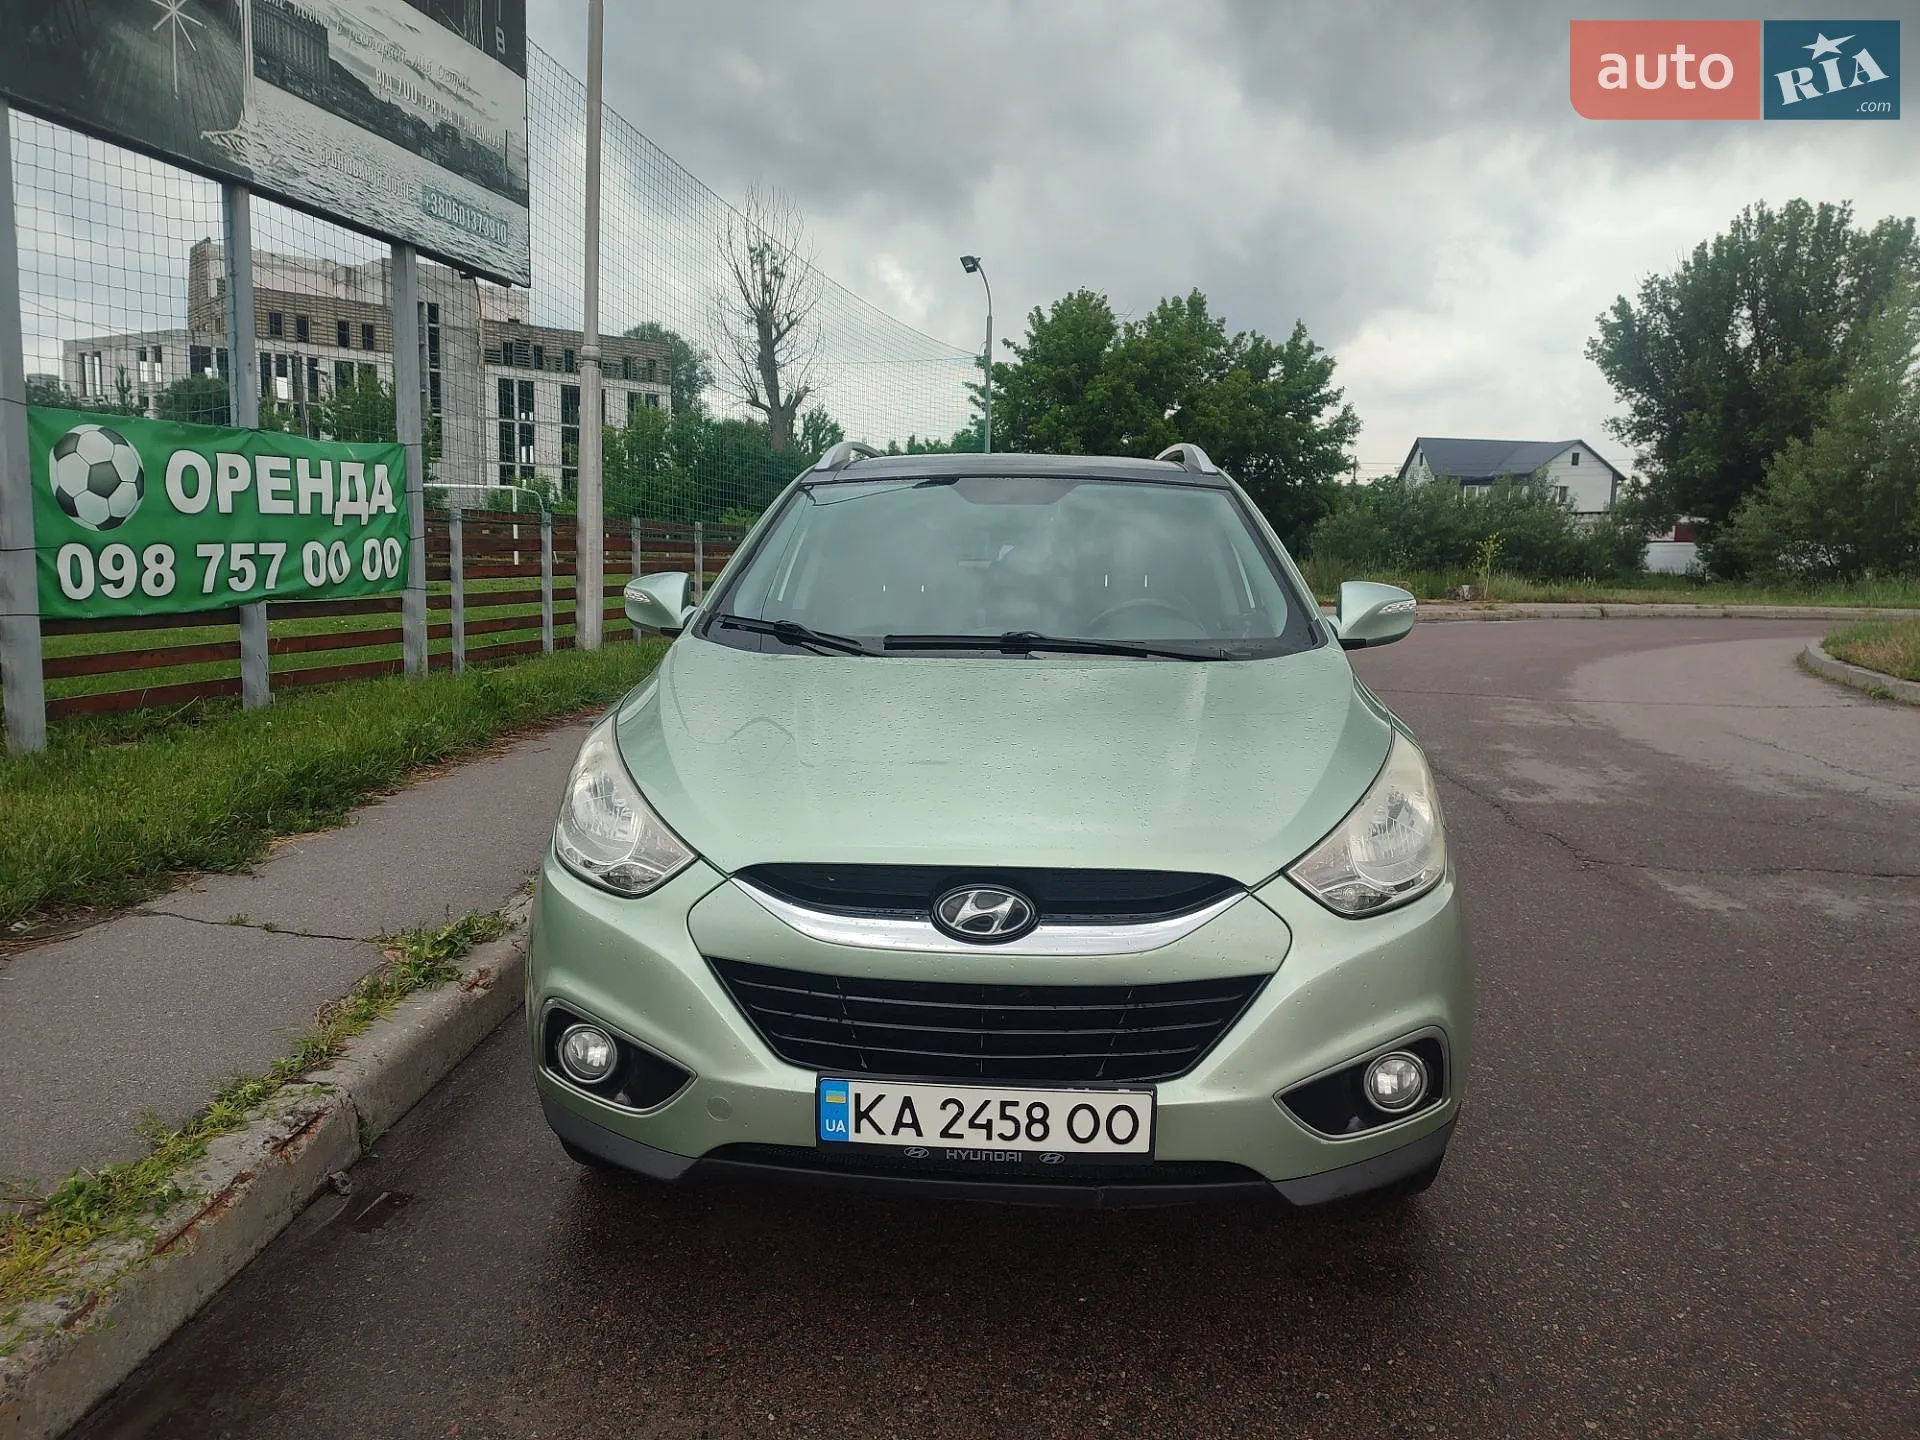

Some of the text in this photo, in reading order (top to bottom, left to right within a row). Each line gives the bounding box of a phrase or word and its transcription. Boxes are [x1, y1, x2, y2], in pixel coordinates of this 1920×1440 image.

[395, 75, 418, 105] 700
[424, 192, 507, 244] +380501373910
[165, 449, 397, 526] ОРЕНДА
[56, 536, 402, 600] 098 757 00 00
[825, 1118, 846, 1133] UA
[854, 1092, 1140, 1145] KA 2458 OO
[946, 1149, 1022, 1163] HYUNDAI
